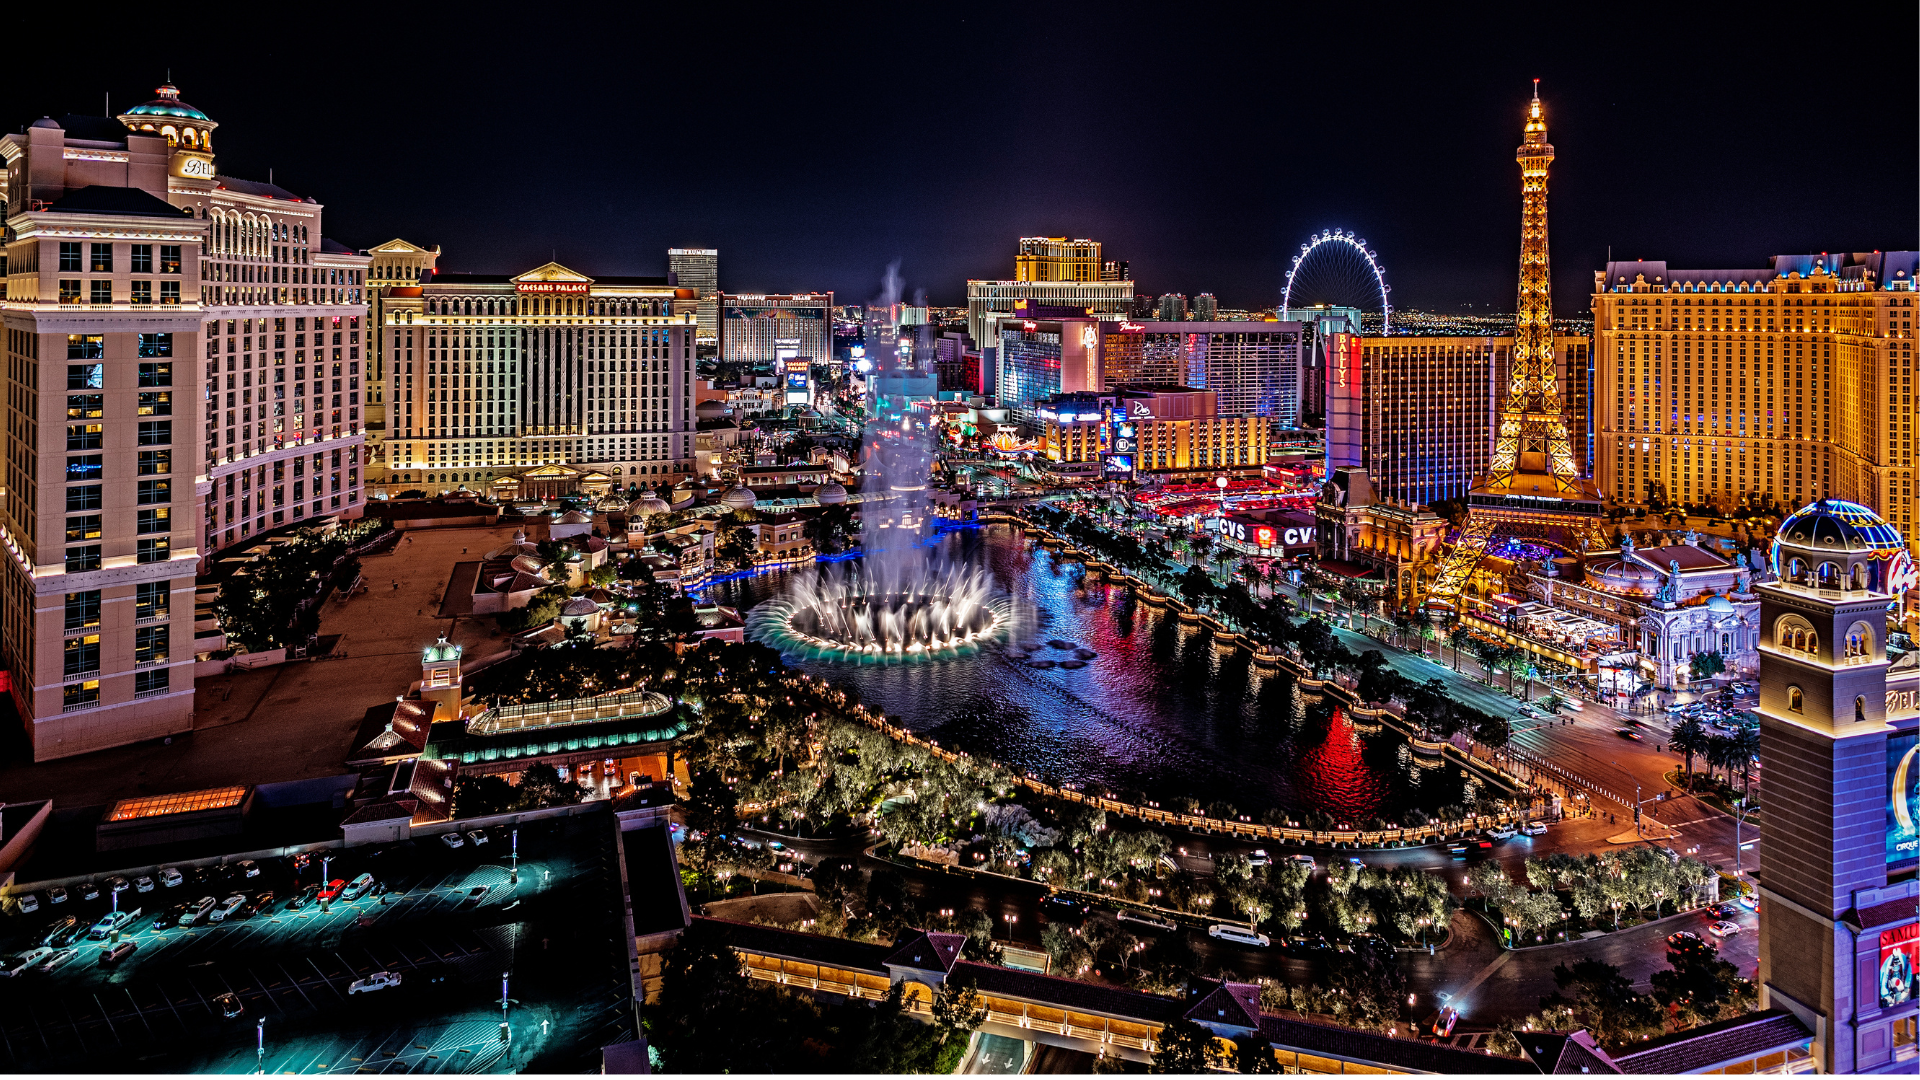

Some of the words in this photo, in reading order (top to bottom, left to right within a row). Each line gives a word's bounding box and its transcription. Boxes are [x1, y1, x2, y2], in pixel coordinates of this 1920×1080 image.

[1219, 518, 1246, 541] CVS
[1284, 527, 1317, 545] CV
[1895, 840, 1919, 851] CIRQUE
